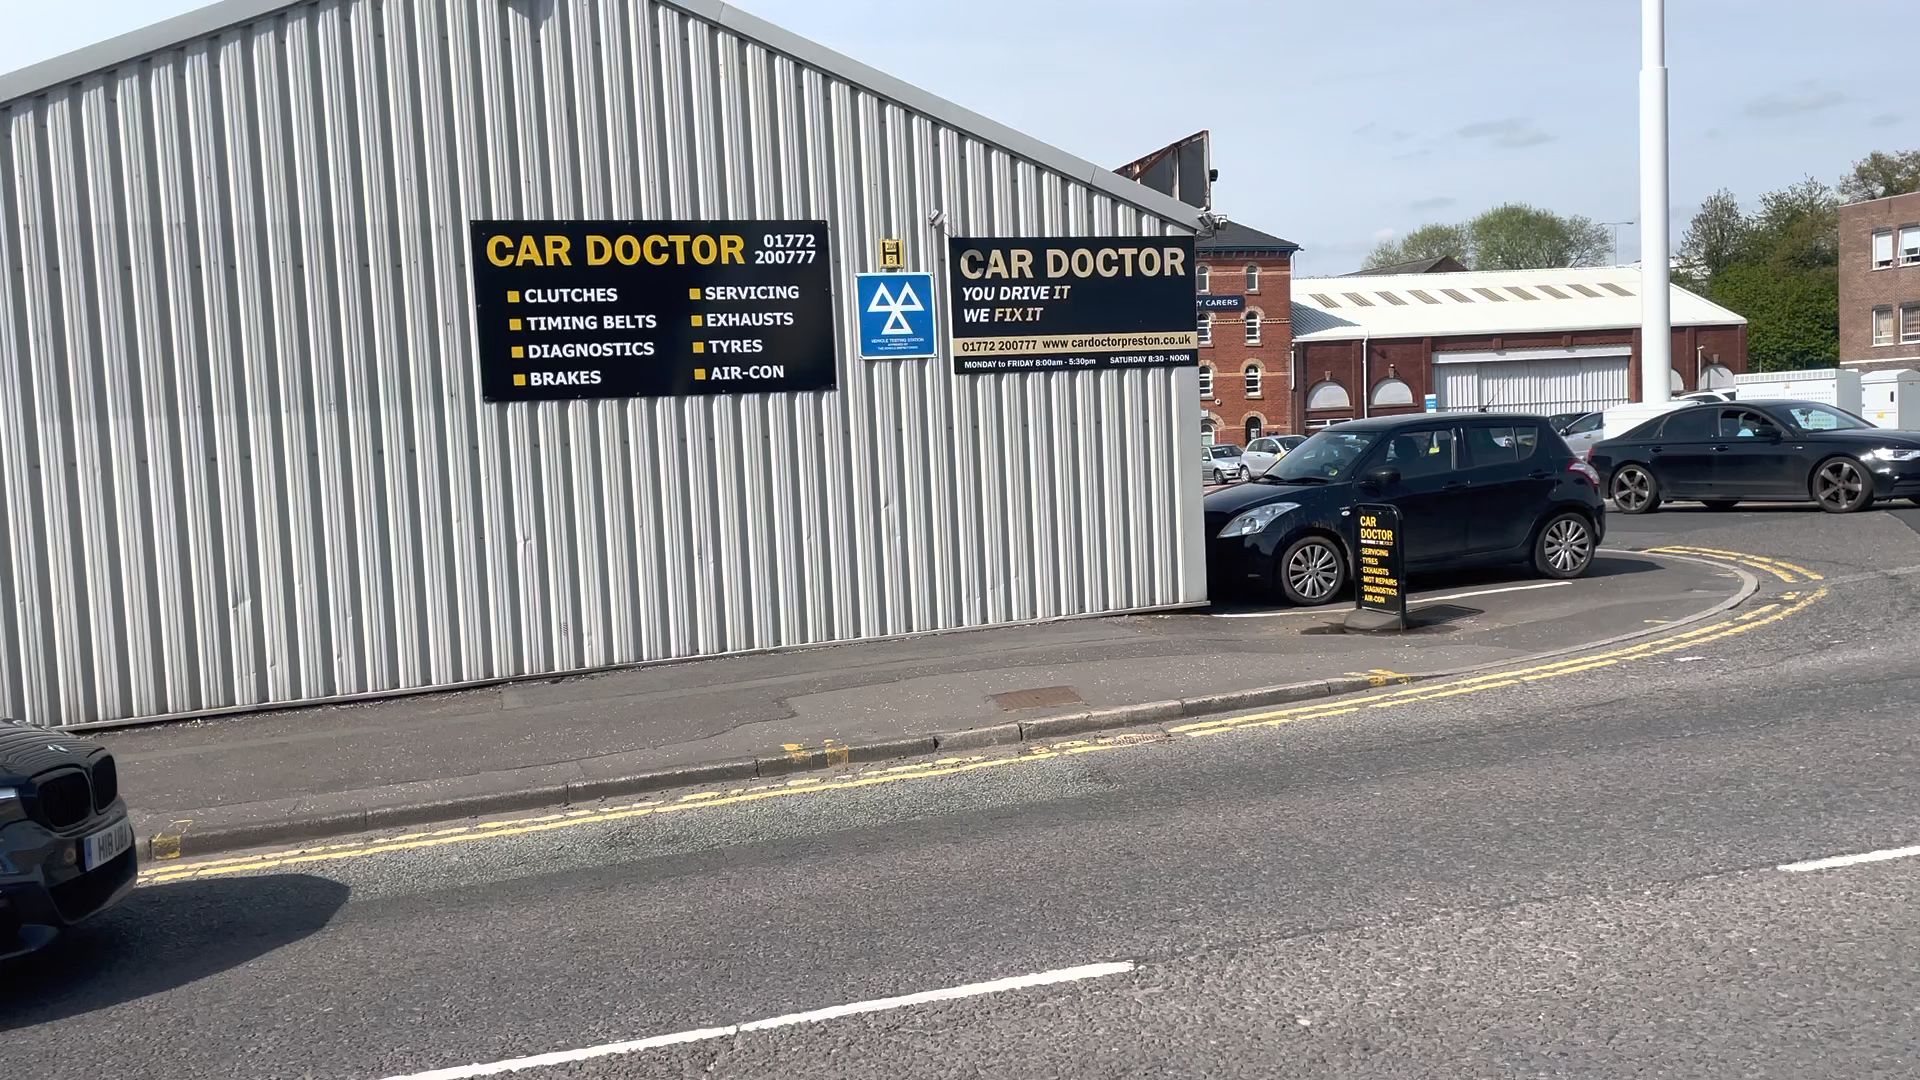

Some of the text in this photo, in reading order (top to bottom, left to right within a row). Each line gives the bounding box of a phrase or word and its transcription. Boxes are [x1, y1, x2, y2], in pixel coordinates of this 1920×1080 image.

[764, 234, 816, 248] 01772
[486, 234, 745, 267] CAR DOCTOR
[754, 250, 816, 265] 200777
[960, 247, 1185, 280] CAR DOCTOR
[525, 288, 618, 303] CLUTCHES
[705, 286, 799, 300] SERVICING
[963, 285, 1071, 301] YOU DRIVE IT
[706, 312, 794, 327] EXHAUSTS
[963, 307, 1044, 323] WE FIX IT
[527, 315, 656, 331] TIMING BELTS
[529, 342, 655, 358] DIAGNOSTICS
[709, 340, 763, 353] TYRES
[962, 335, 1191, 353] 01772 200777 www cardoctorpreston.co.uk
[964, 360, 995, 369] MONDAY
[1007, 358, 1033, 367] FRIDAY
[1035, 358, 1063, 366] 8:00am
[1069, 357, 1096, 367] 5:30pm
[1110, 355, 1146, 364] SATURDAY
[1148, 355, 1164, 363] 8:30
[1170, 354, 1190, 362] NOON
[530, 371, 602, 386] BRAKES
[710, 365, 784, 380] AIR-CON
[1360, 516, 1376, 527] CAR
[1360, 528, 1393, 540] DOCTOR
[1362, 548, 1388, 556] SERVICING
[1362, 557, 1378, 565] TYRES
[1363, 566, 1389, 576] EXHAUSTS
[1375, 577, 1397, 586] REPAIRS
[1364, 585, 1397, 596] DIAGNOSTICS
[1364, 594, 1385, 603] AIR-CON
